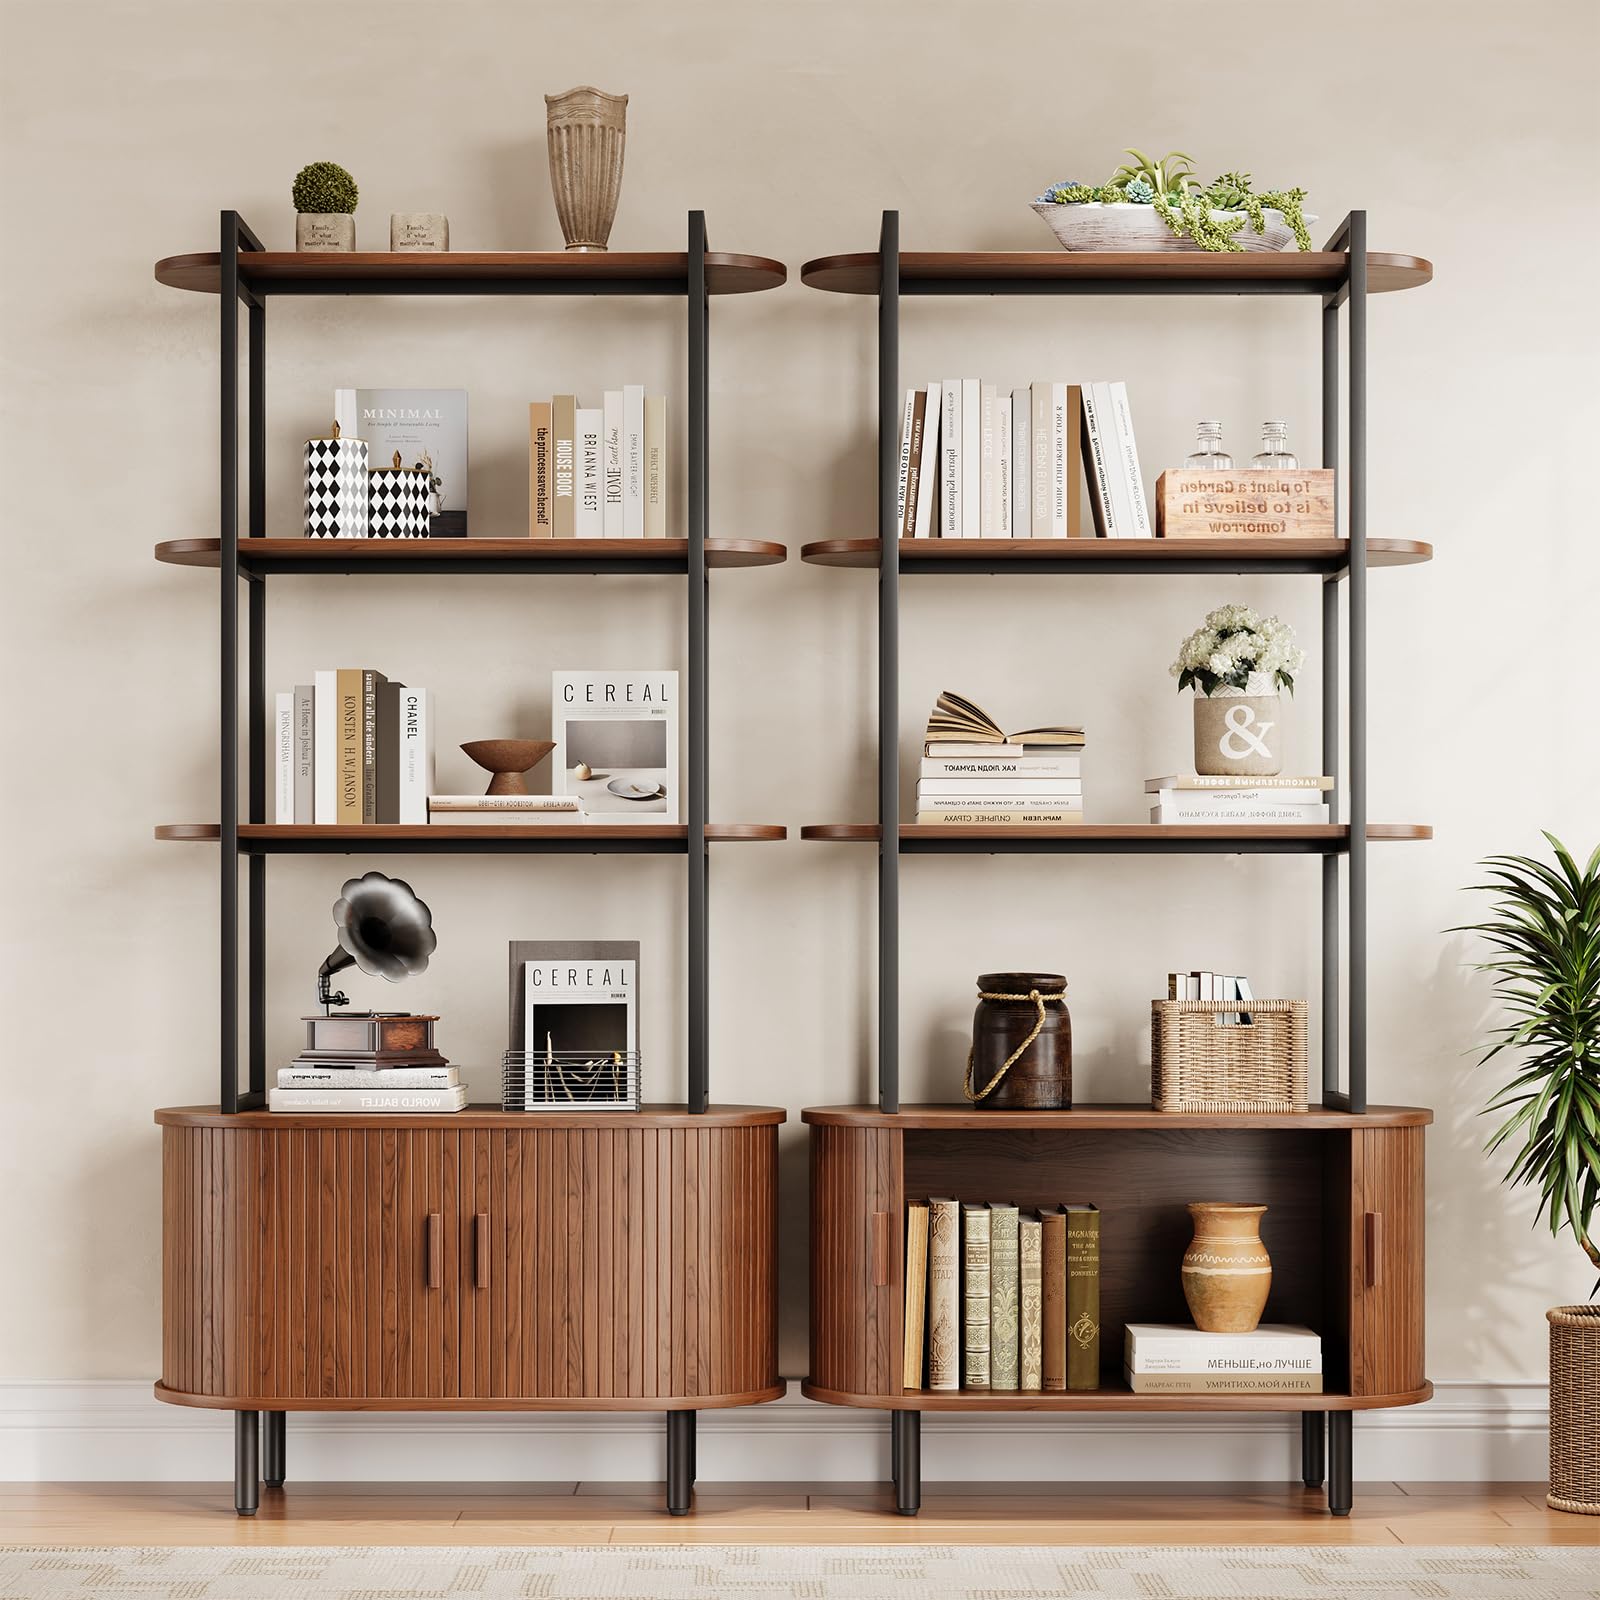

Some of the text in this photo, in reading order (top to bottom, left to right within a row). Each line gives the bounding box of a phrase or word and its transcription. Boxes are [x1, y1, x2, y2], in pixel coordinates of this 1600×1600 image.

[363, 409, 443, 418] MINIMAL
[556, 440, 572, 497] HOUSE BOOK
[650, 448, 658, 471] PERFECT
[584, 434, 596, 511] BRIANNA WIEST
[606, 467, 621, 503] HOME
[301, 698, 310, 706] At
[366, 694, 375, 704] für
[564, 684, 668, 702] CEREAL
[301, 709, 310, 728] Home
[344, 696, 356, 740] KONSTEN
[366, 706, 375, 719] alla
[407, 696, 417, 739] CHANEL
[366, 721, 375, 732] die
[1219, 704, 1275, 759] &
[299, 737, 310, 760] Joshua
[366, 734, 375, 765] sünderin
[301, 763, 310, 776] Tree
[533, 969, 628, 986] CEREAL
[1274, 1359, 1312, 1368] ЛУЧШЕ
[1282, 1381, 1311, 1389] АНГЕЛ
